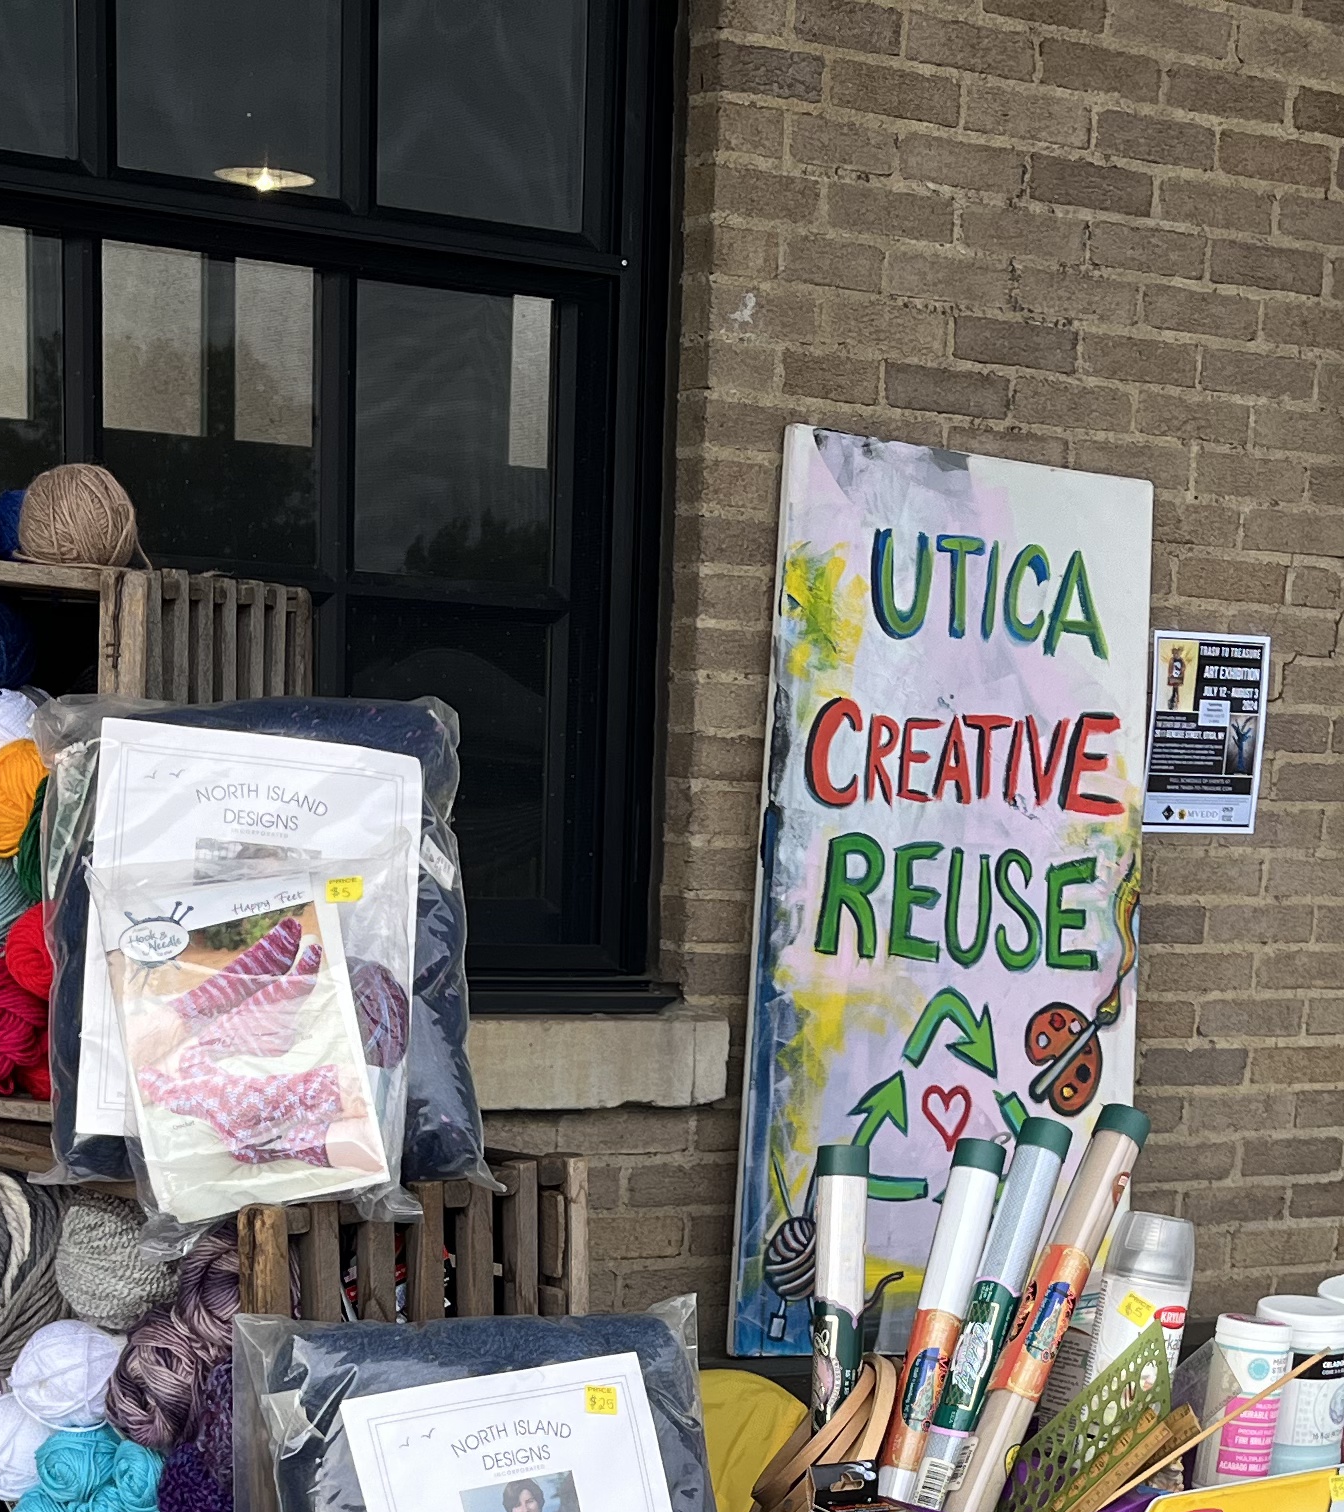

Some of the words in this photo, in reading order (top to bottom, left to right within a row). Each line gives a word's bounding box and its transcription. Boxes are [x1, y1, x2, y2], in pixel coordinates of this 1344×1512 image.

[871, 528, 1108, 658] UTICA
[1231, 648, 1261, 659] TREASURE
[1203, 665, 1219, 679] ART
[1219, 666, 1260, 681] EXHIBITION
[1203, 686, 1218, 697] JULY
[806, 696, 1126, 817] CREATIVE
[196, 783, 259, 803] NORTH
[267, 785, 329, 817] ISLAND
[223, 808, 299, 831] DESIGNS
[232, 899, 271, 915] Happy
[275, 890, 305, 904] Feet
[330, 887, 351, 898] $5
[815, 833, 1099, 972] REUSE
[128, 930, 158, 947] Hook
[147, 936, 182, 953] Needle
[587, 1386, 613, 1394] PRICE
[589, 1395, 615, 1411] $25
[451, 1422, 509, 1458] NORTH
[513, 1419, 572, 1439] ISLAND
[482, 1444, 551, 1471] DESIGNS
